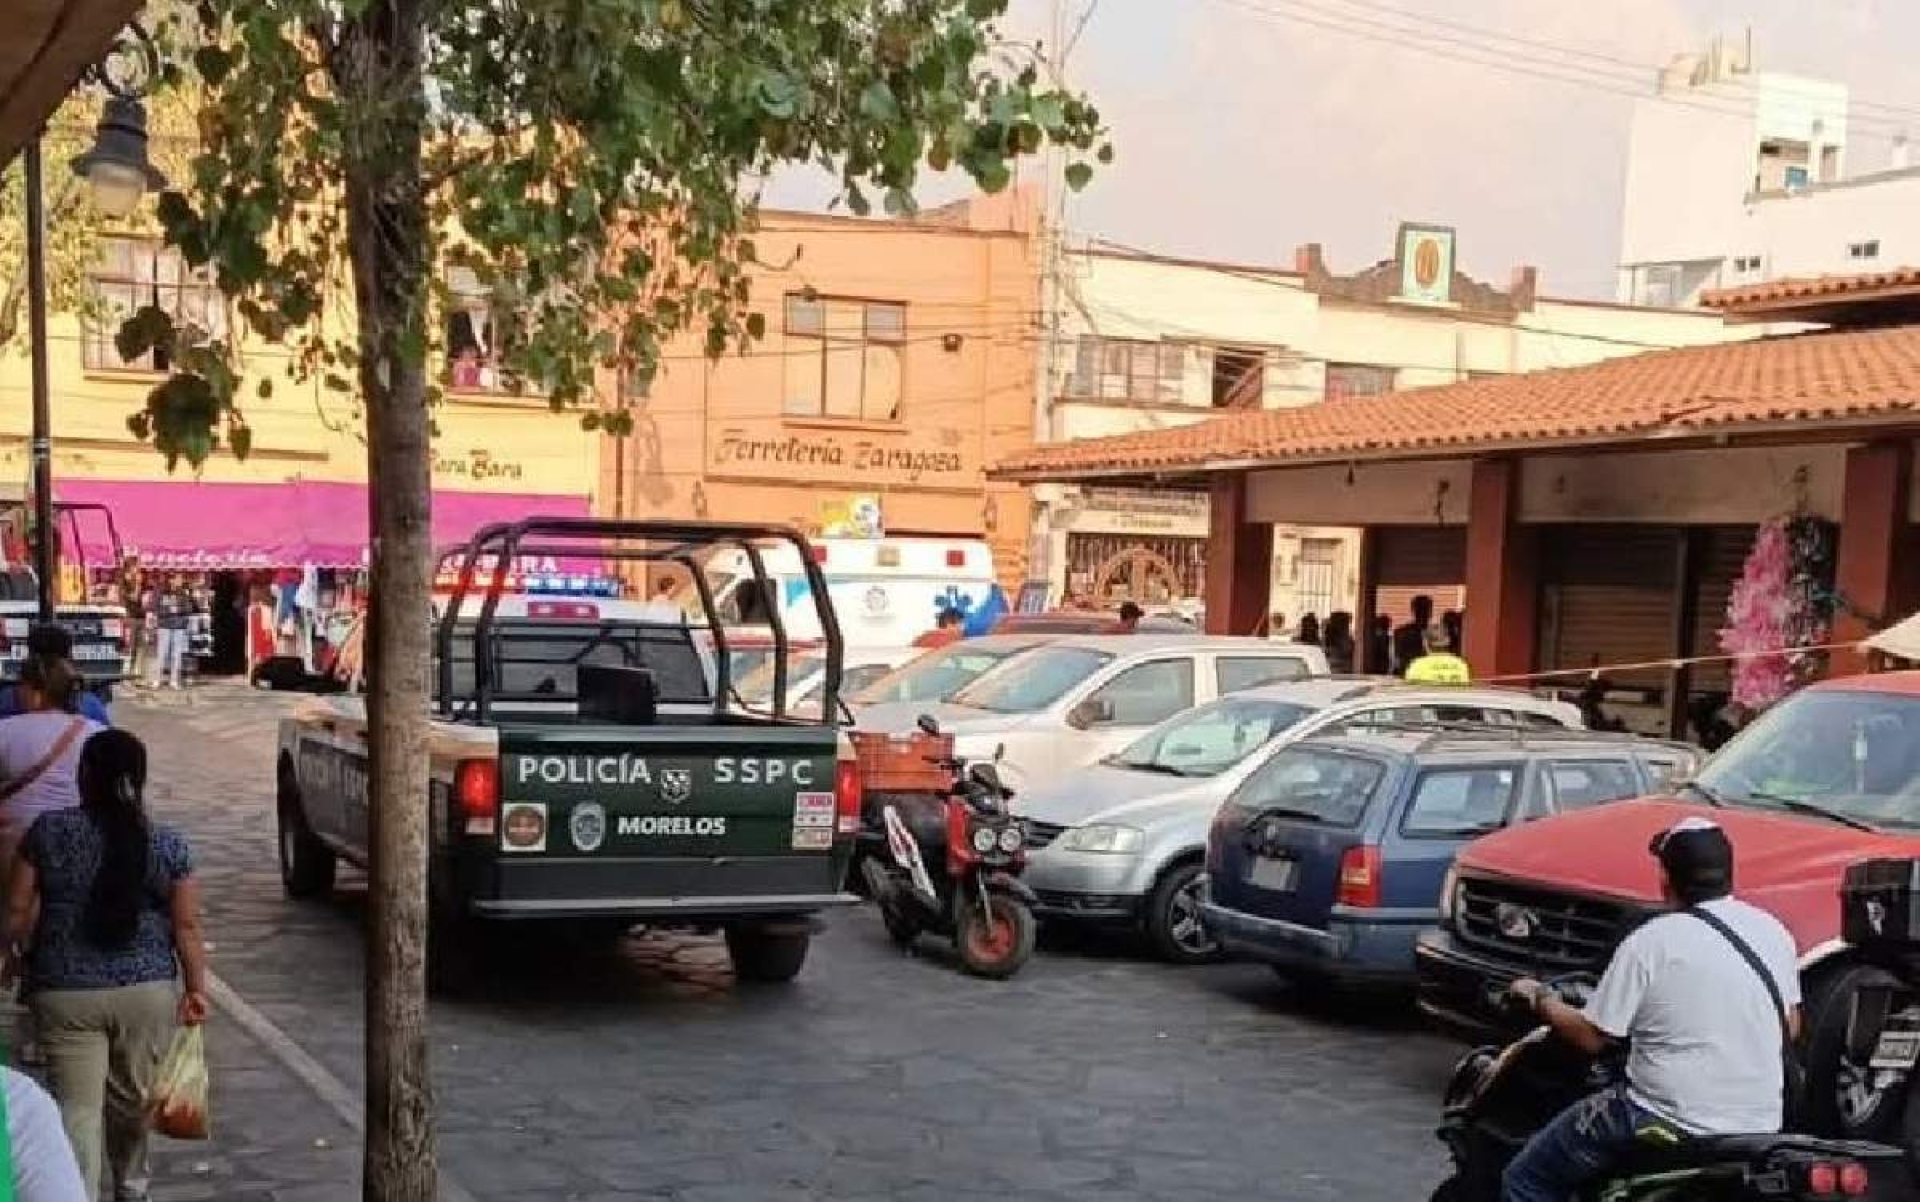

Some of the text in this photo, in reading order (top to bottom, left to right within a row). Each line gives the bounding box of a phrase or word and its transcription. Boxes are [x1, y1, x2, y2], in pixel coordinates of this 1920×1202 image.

[853, 441, 963, 481] Zaragoza
[517, 753, 814, 785] POLICÍA SSPC
[617, 816, 727, 836] MORELOS
